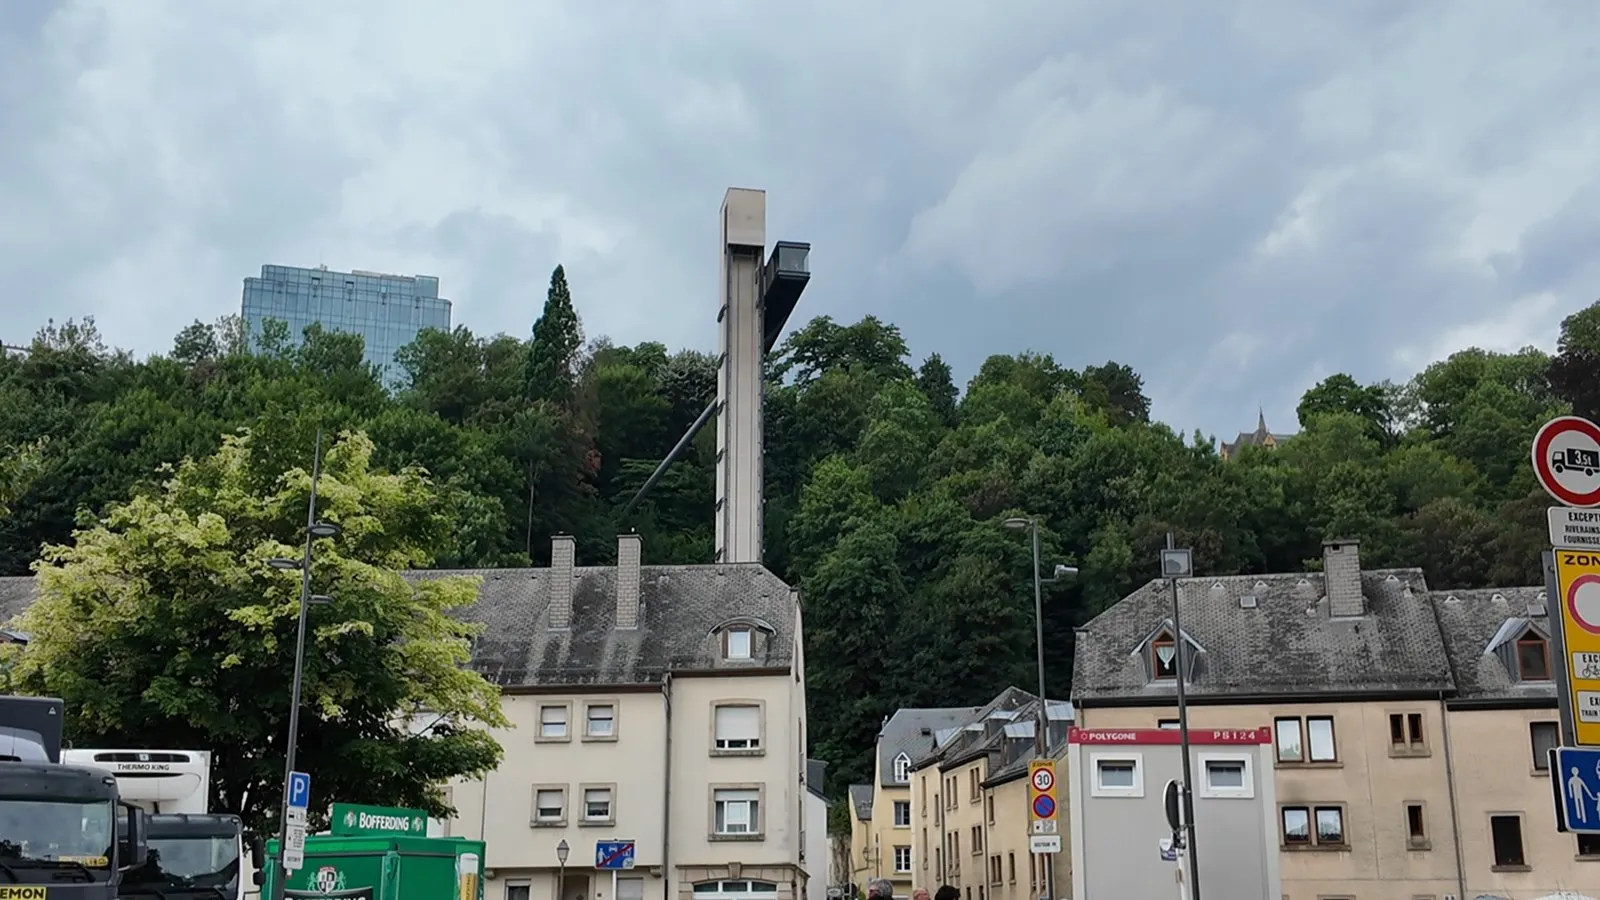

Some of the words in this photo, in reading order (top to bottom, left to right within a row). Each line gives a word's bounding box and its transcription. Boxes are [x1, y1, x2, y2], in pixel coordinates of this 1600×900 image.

[1568, 511, 1600, 522] EXCEPT
[1582, 654, 1600, 664] EXC
[1589, 697, 1600, 706] EX
[1089, 732, 1137, 741] POLYGONE
[117, 763, 150, 771] THERMO
[1036, 774, 1050, 786] 30
[292, 777, 305, 803] P
[359, 812, 409, 831] BOFFERDING
